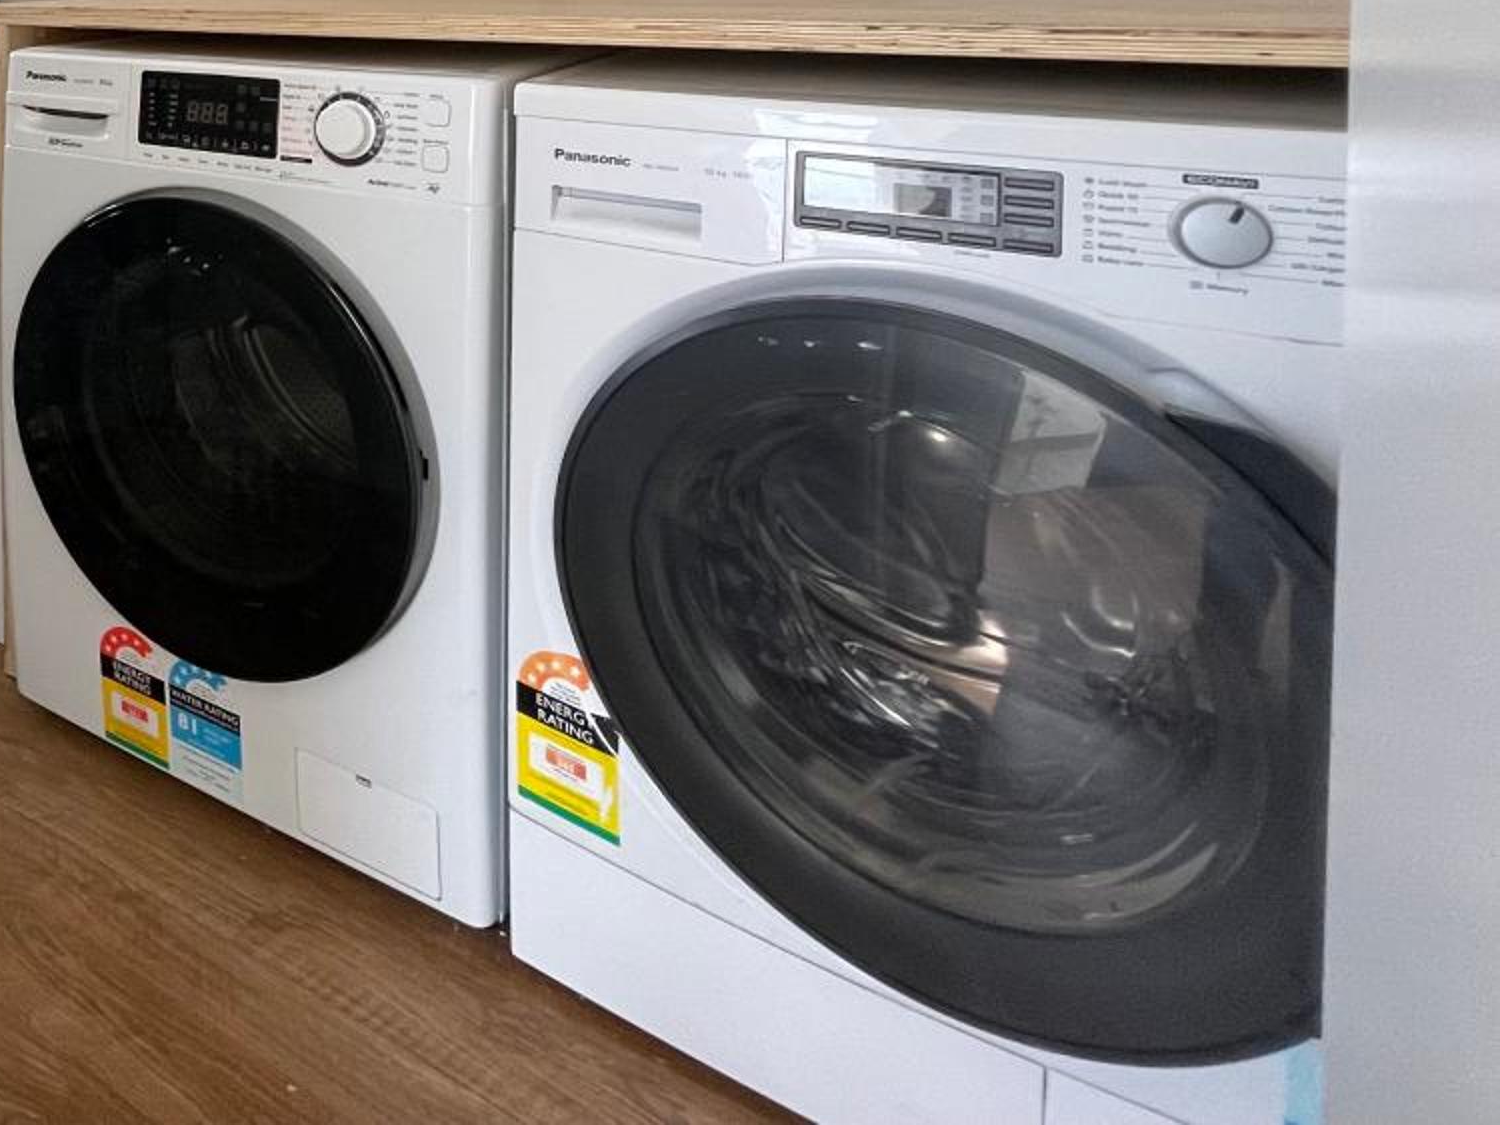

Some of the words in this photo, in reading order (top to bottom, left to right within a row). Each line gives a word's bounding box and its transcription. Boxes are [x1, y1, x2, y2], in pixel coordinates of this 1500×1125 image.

[26, 70, 67, 82] Panasonic
[554, 147, 632, 167] Panasonic
[537, 708, 594, 744] RATING
